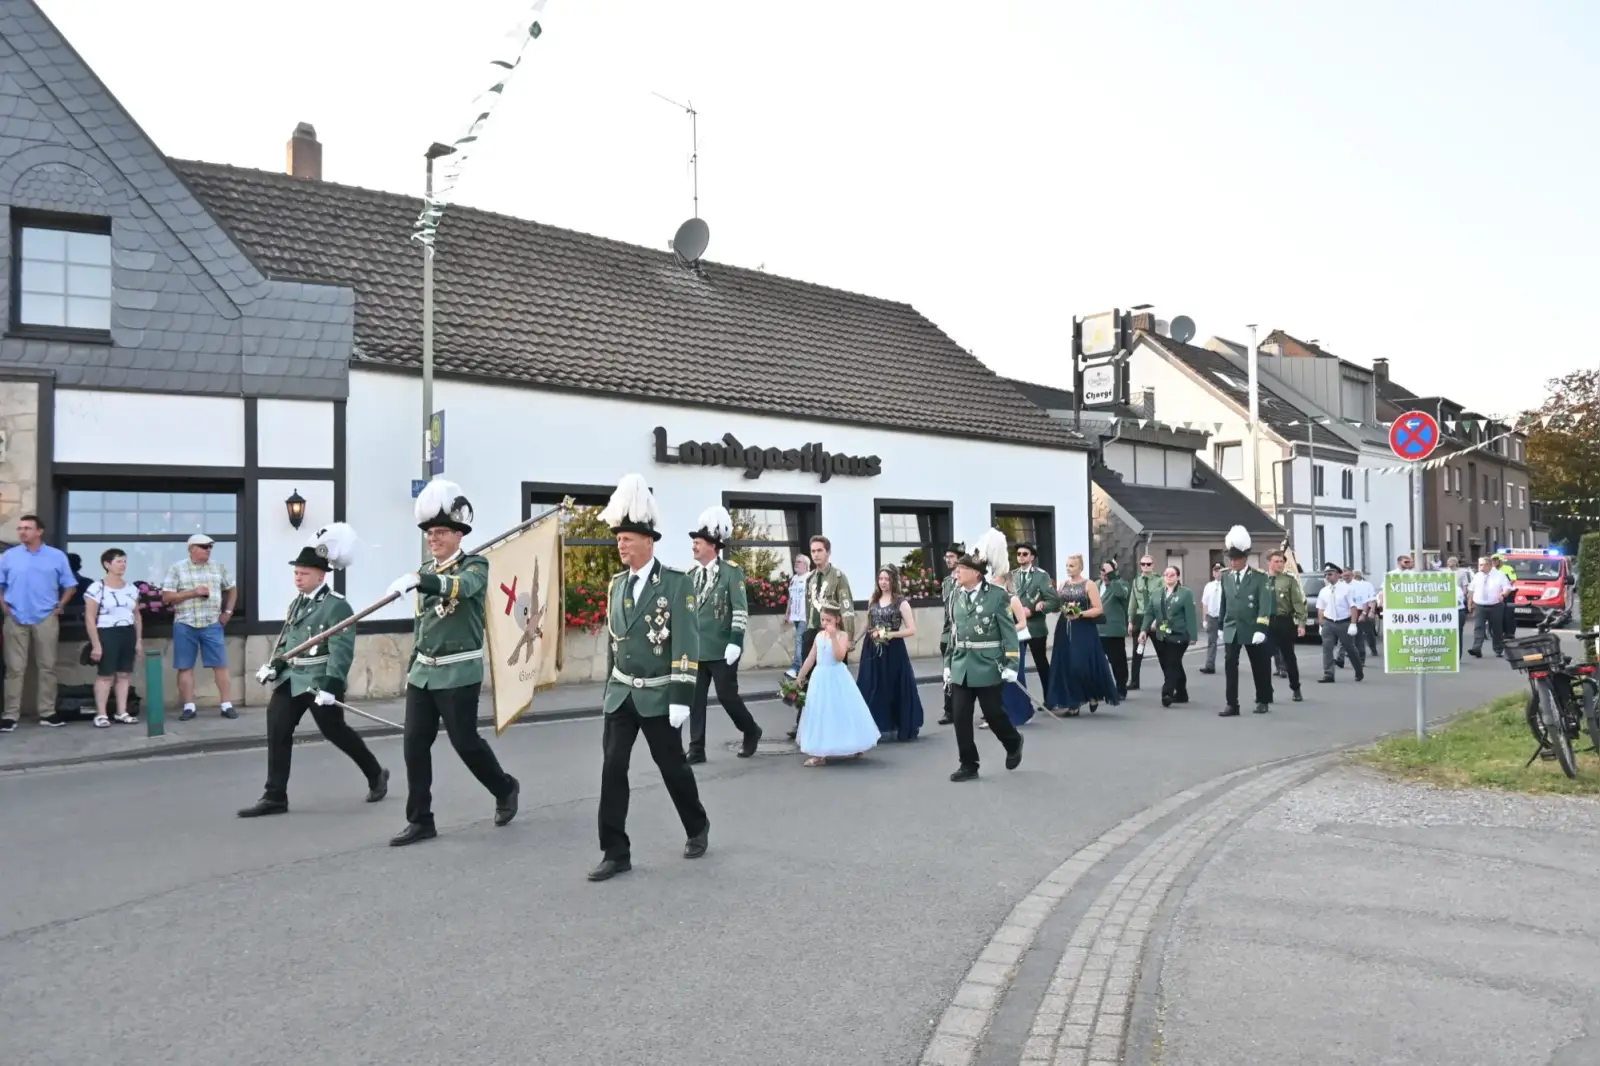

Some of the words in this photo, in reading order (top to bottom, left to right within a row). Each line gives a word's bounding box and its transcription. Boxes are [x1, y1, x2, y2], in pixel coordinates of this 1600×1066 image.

[653, 426, 882, 483] Landgasthaus
[1392, 614, 1420, 623] 30.08
[1429, 613, 1452, 623] 01.09
[1402, 635, 1446, 647] Festplatz
